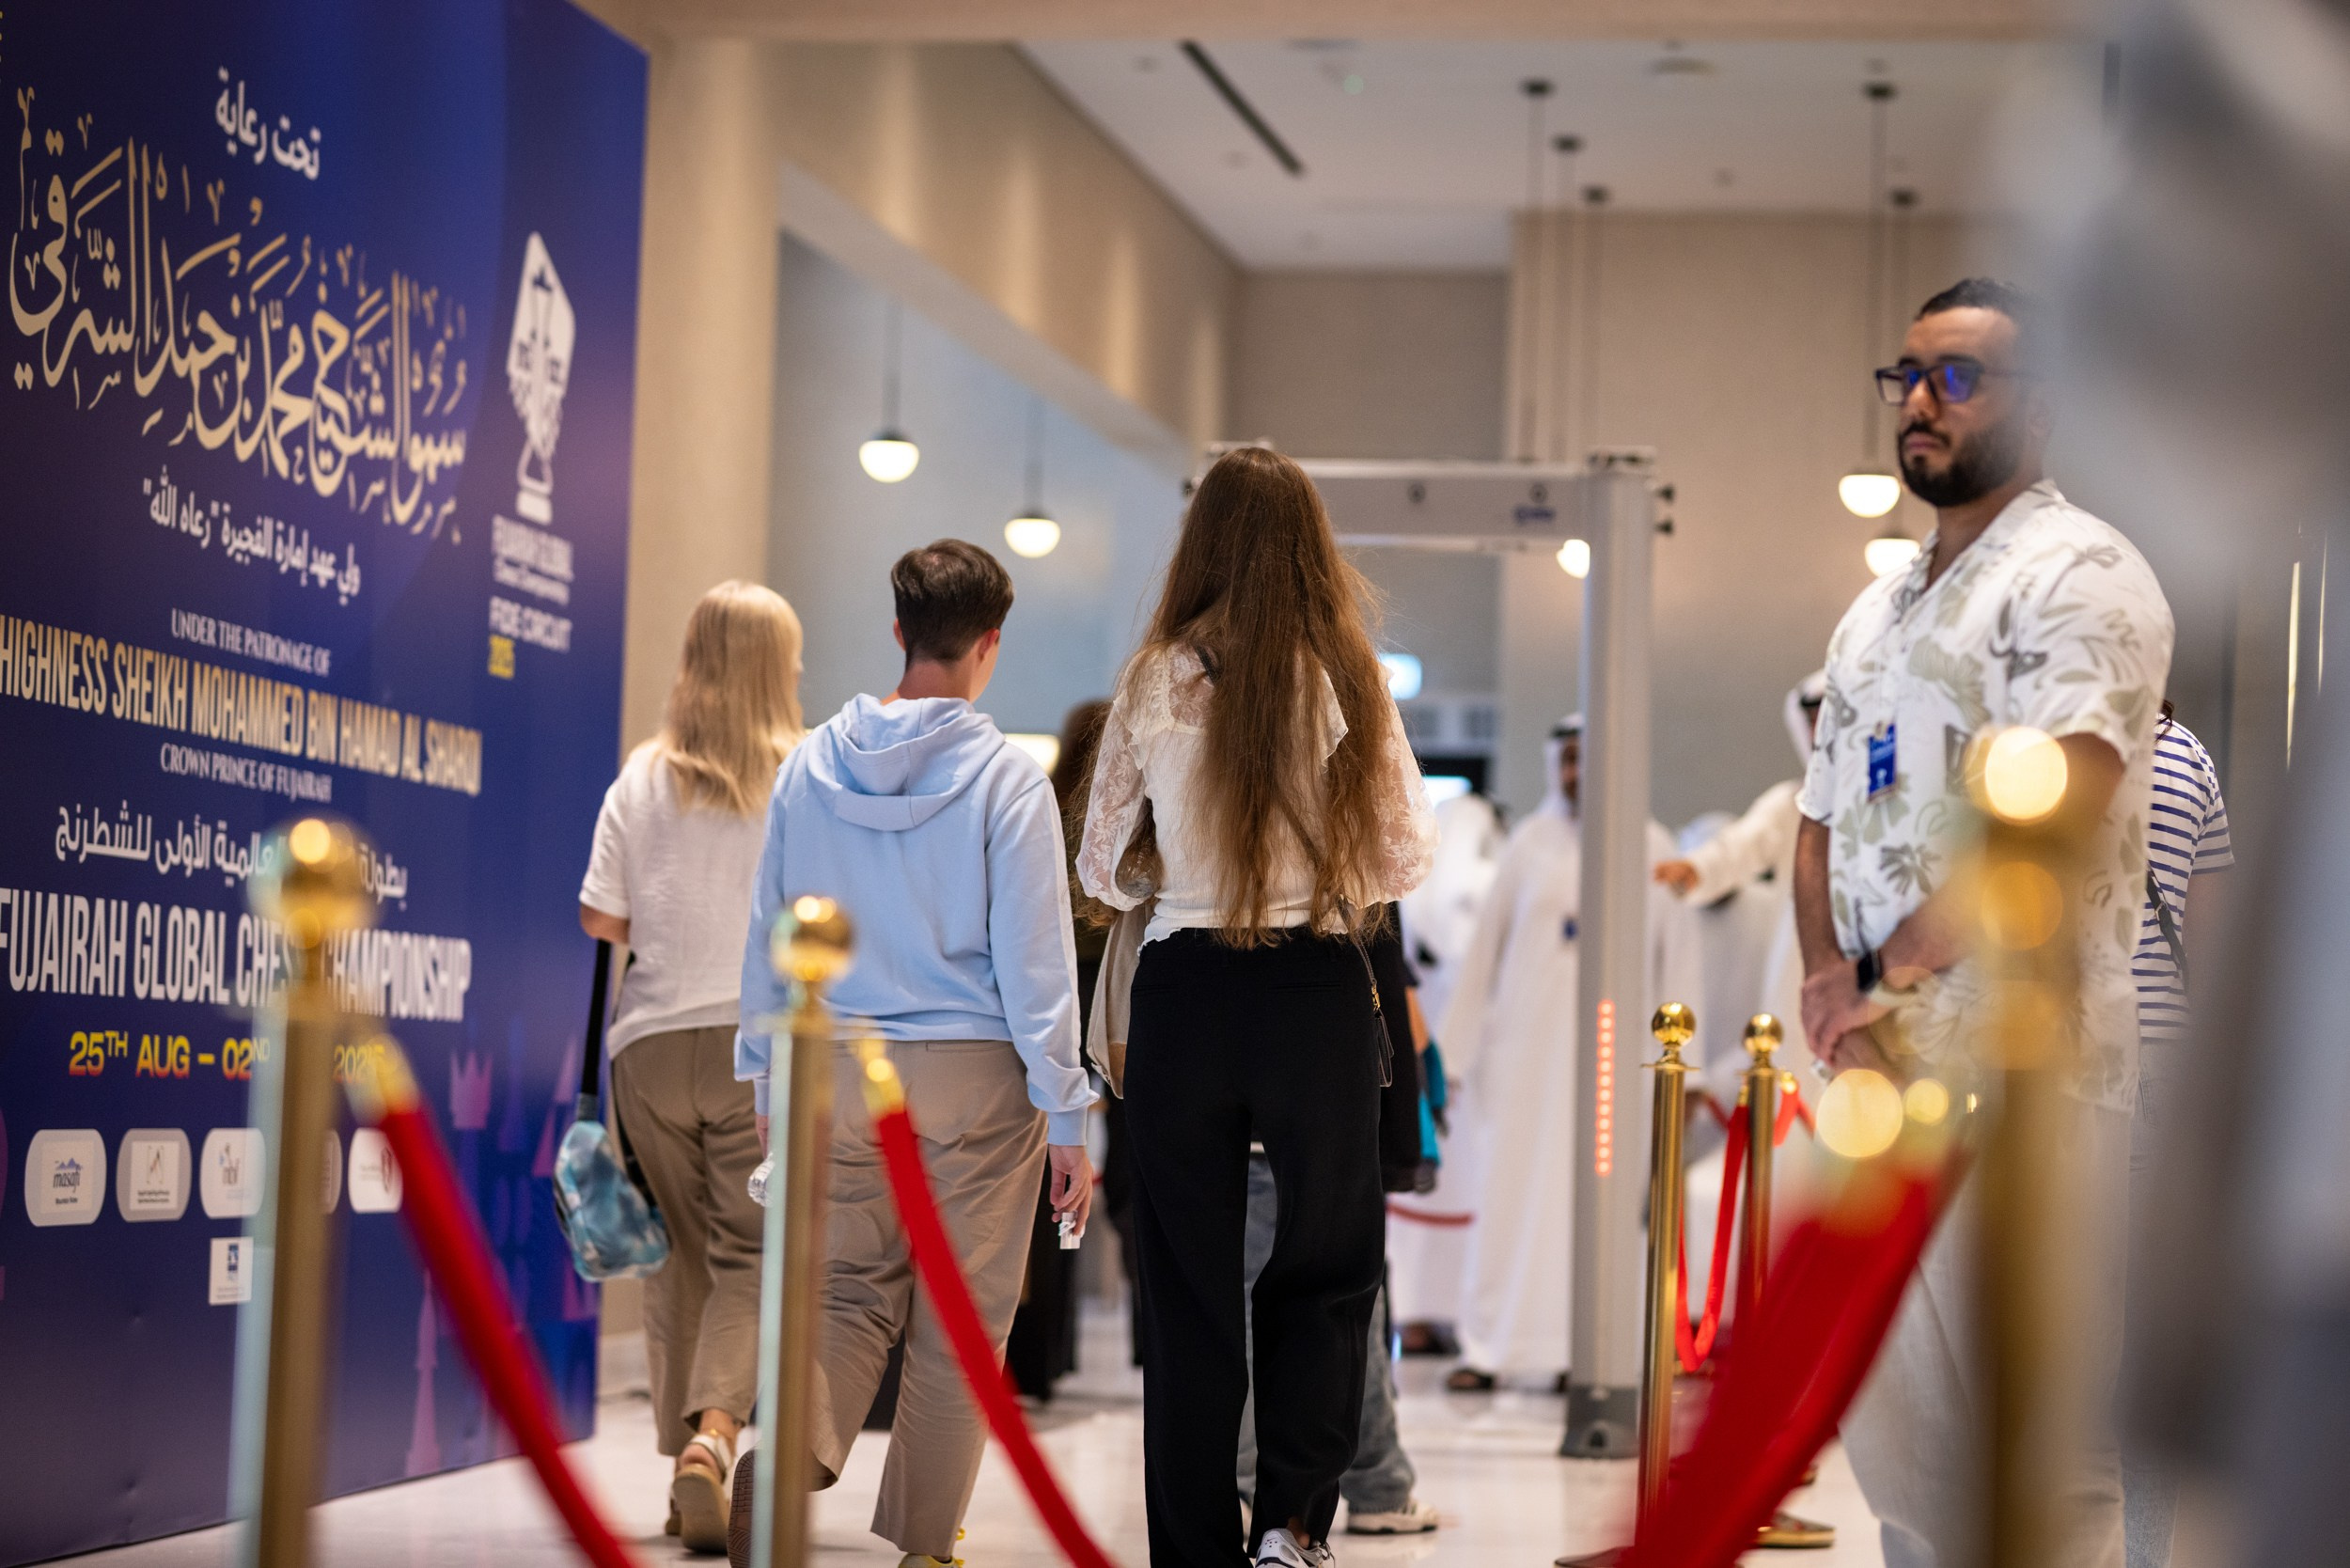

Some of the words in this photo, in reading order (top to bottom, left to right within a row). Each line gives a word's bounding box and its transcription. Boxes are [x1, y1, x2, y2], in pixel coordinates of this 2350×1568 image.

[215, 66, 268, 165] رعاية
[272, 114, 321, 180] تحت
[222, 502, 274, 566] الفجيرة
[171, 607, 216, 648] UNDER
[218, 619, 243, 655] THE
[243, 627, 313, 674] PATRONAGE
[313, 646, 331, 678] OF
[0, 614, 108, 716] HIGHNESS
[112, 641, 188, 733] SHEIKH
[191, 660, 305, 758] MOHAMMED
[306, 688, 337, 765] BIN
[339, 697, 400, 778] HAMAD
[400, 713, 423, 784] AL
[161, 743, 210, 778] CROWN
[212, 753, 257, 790] PRINCE
[258, 761, 275, 792] OF
[55, 799, 152, 864] للشطرنج
[155, 814, 212, 879] الأولى
[213, 819, 287, 887] عالمية
[358, 841, 408, 912] بطولة
[133, 901, 230, 1006] GLOBAL
[69, 1030, 128, 1077] 25TH
[135, 1035, 190, 1078] AUG
